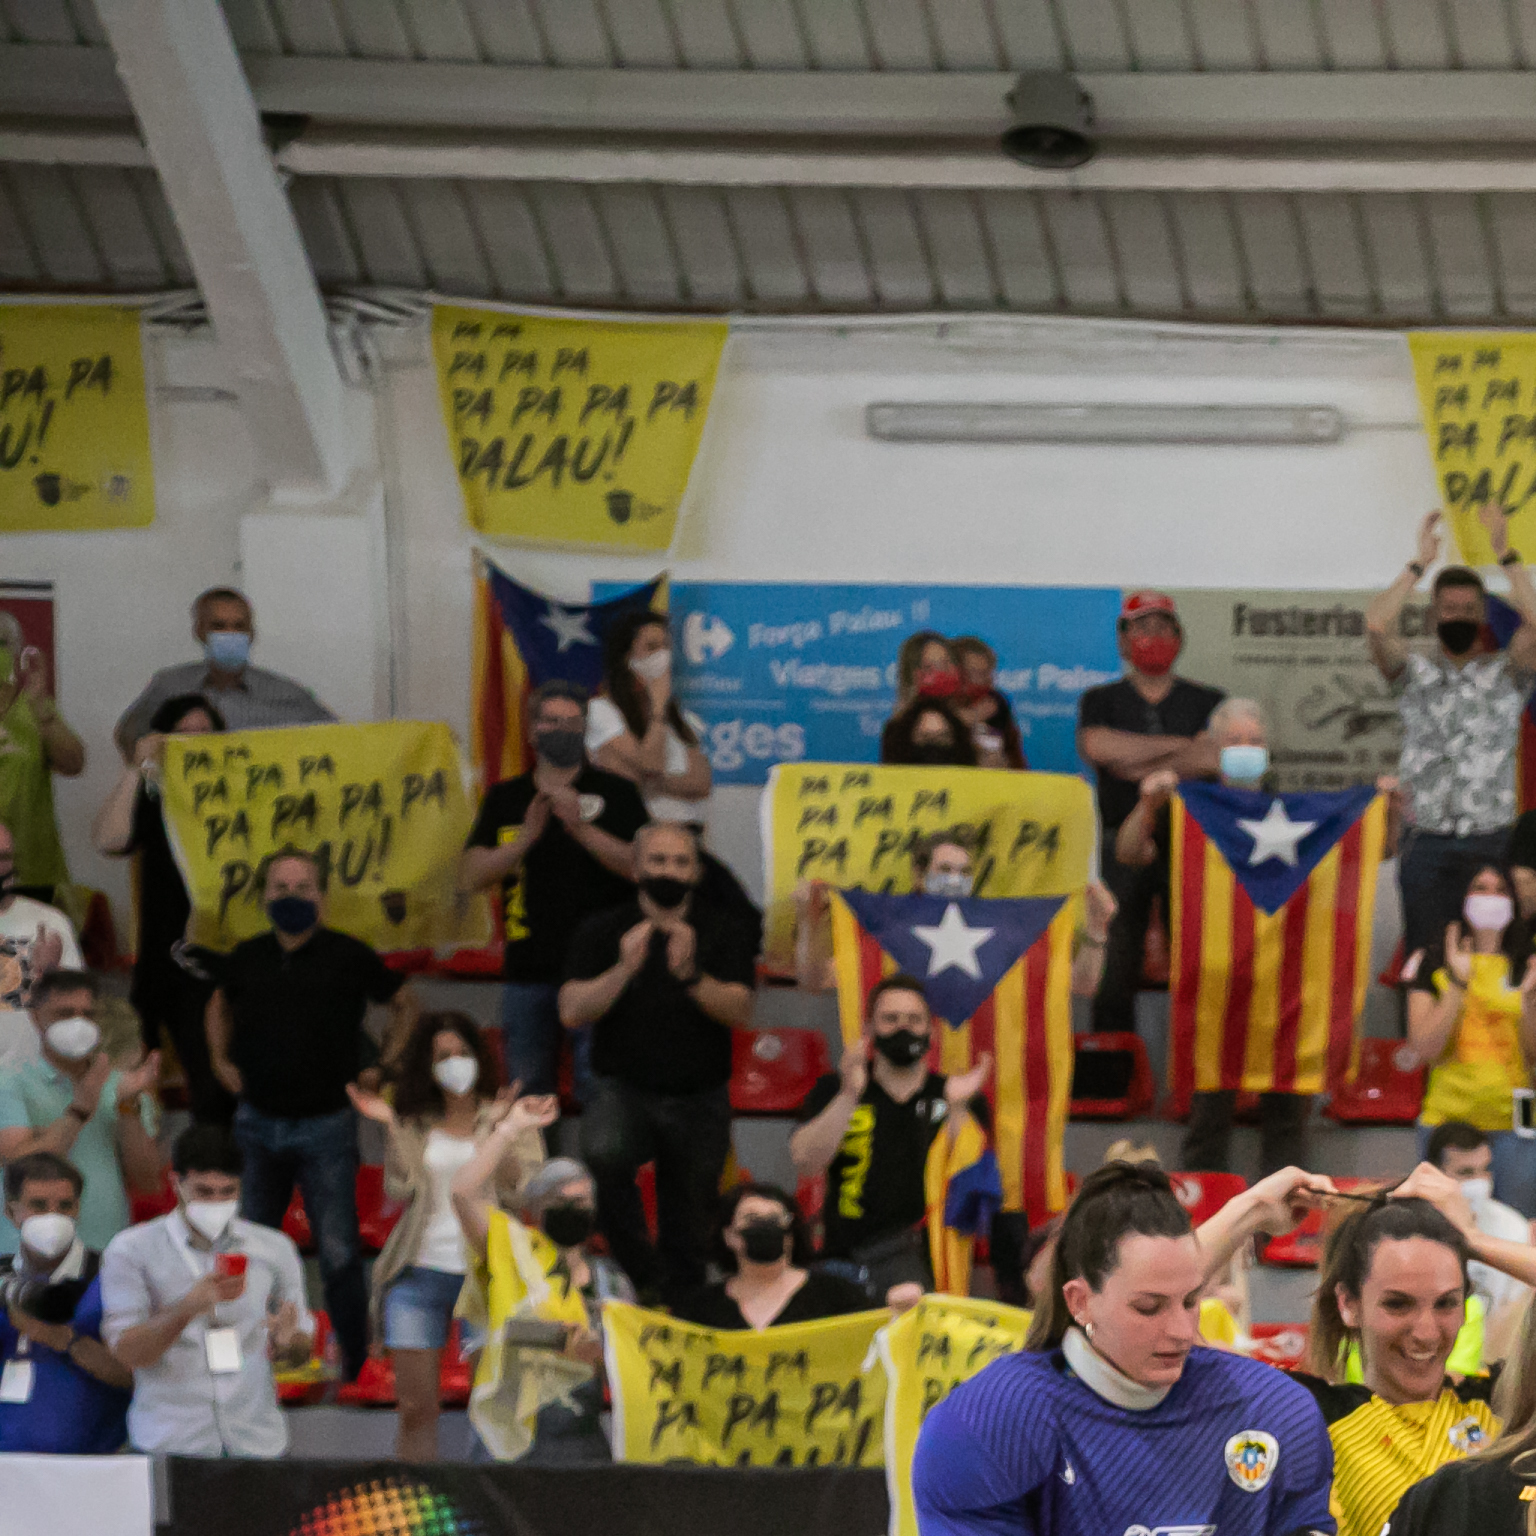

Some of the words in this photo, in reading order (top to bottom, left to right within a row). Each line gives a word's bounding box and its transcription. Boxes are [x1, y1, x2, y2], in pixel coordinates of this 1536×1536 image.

[0, 366, 48, 411] PA
[65, 355, 112, 400] PA
[453, 385, 496, 430] PA
[511, 385, 562, 429] PA
[579, 383, 632, 428] PA
[647, 379, 698, 425] PA
[459, 415, 634, 492] PALAU!
[1438, 420, 1479, 461] PA
[204, 810, 250, 858] PA
[271, 789, 319, 840] PA
[338, 780, 384, 830] PA
[401, 767, 448, 819] PA
[797, 836, 849, 878] PA
[1009, 820, 1061, 863] PA
[651, 1400, 699, 1452] PA
[721, 1390, 780, 1450] PA
[805, 1376, 862, 1434] PA
